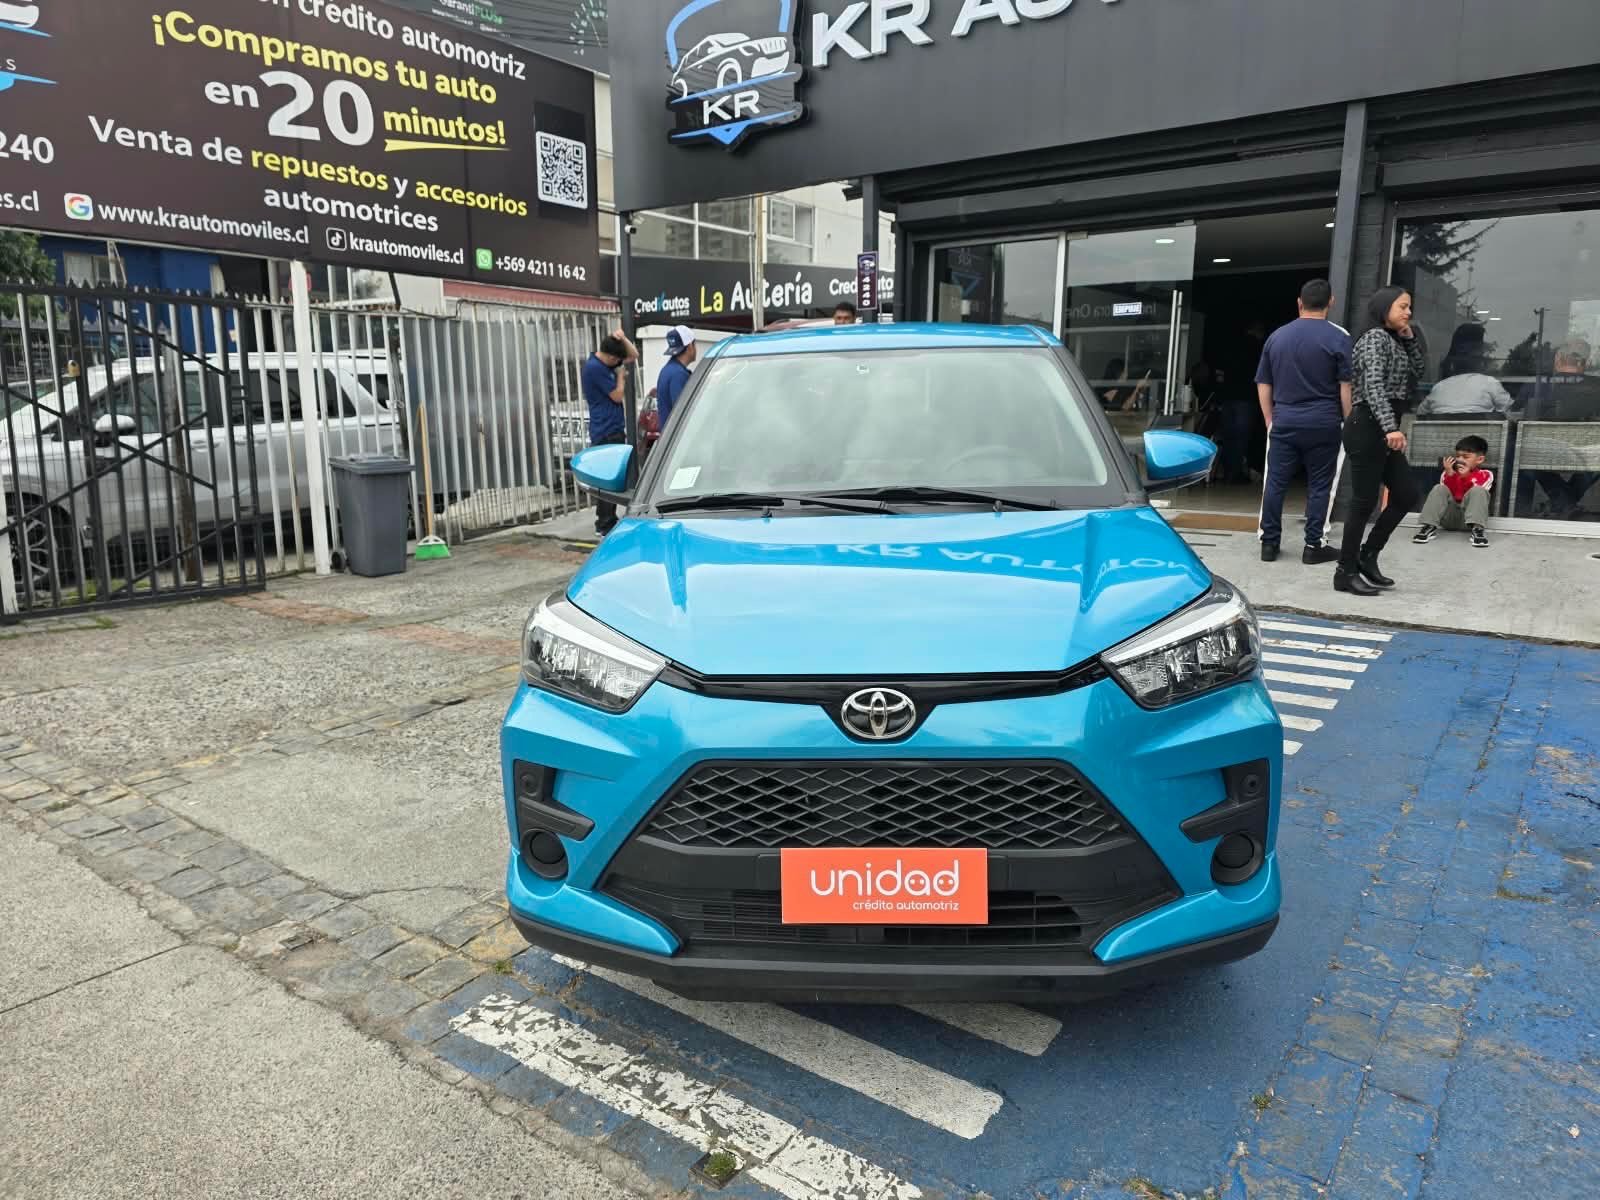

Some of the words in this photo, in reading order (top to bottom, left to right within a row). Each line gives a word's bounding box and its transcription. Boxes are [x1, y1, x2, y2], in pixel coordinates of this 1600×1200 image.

[152, 11, 389, 81] ¡Compramos
[395, 60, 428, 90] tu
[435, 74, 497, 104] auto
[402, 25, 527, 80] automotriz
[204, 80, 260, 108] en
[259, 70, 375, 146] 20
[384, 107, 506, 145] minutos!
[702, 90, 760, 125] KR
[88, 115, 193, 157] Venta
[202, 137, 243, 165] de
[251, 149, 389, 191] repuestos
[393, 175, 409, 199] y
[415, 180, 528, 217] accesorios
[0, 190, 40, 212] s.cl
[264, 188, 439, 232] automotrices
[98, 203, 309, 245] www.krautomoviles.cl
[350, 232, 464, 265] krautomoviles.cl
[495, 258, 526, 273] +569
[527, 259, 554, 276] 4211
[557, 263, 571, 279] 16
[572, 265, 586, 281] 42
[701, 286, 724, 314] La
[810, 859, 960, 896] unidad
[852, 900, 894, 911] crédito
[896, 900, 959, 911] automotriz
